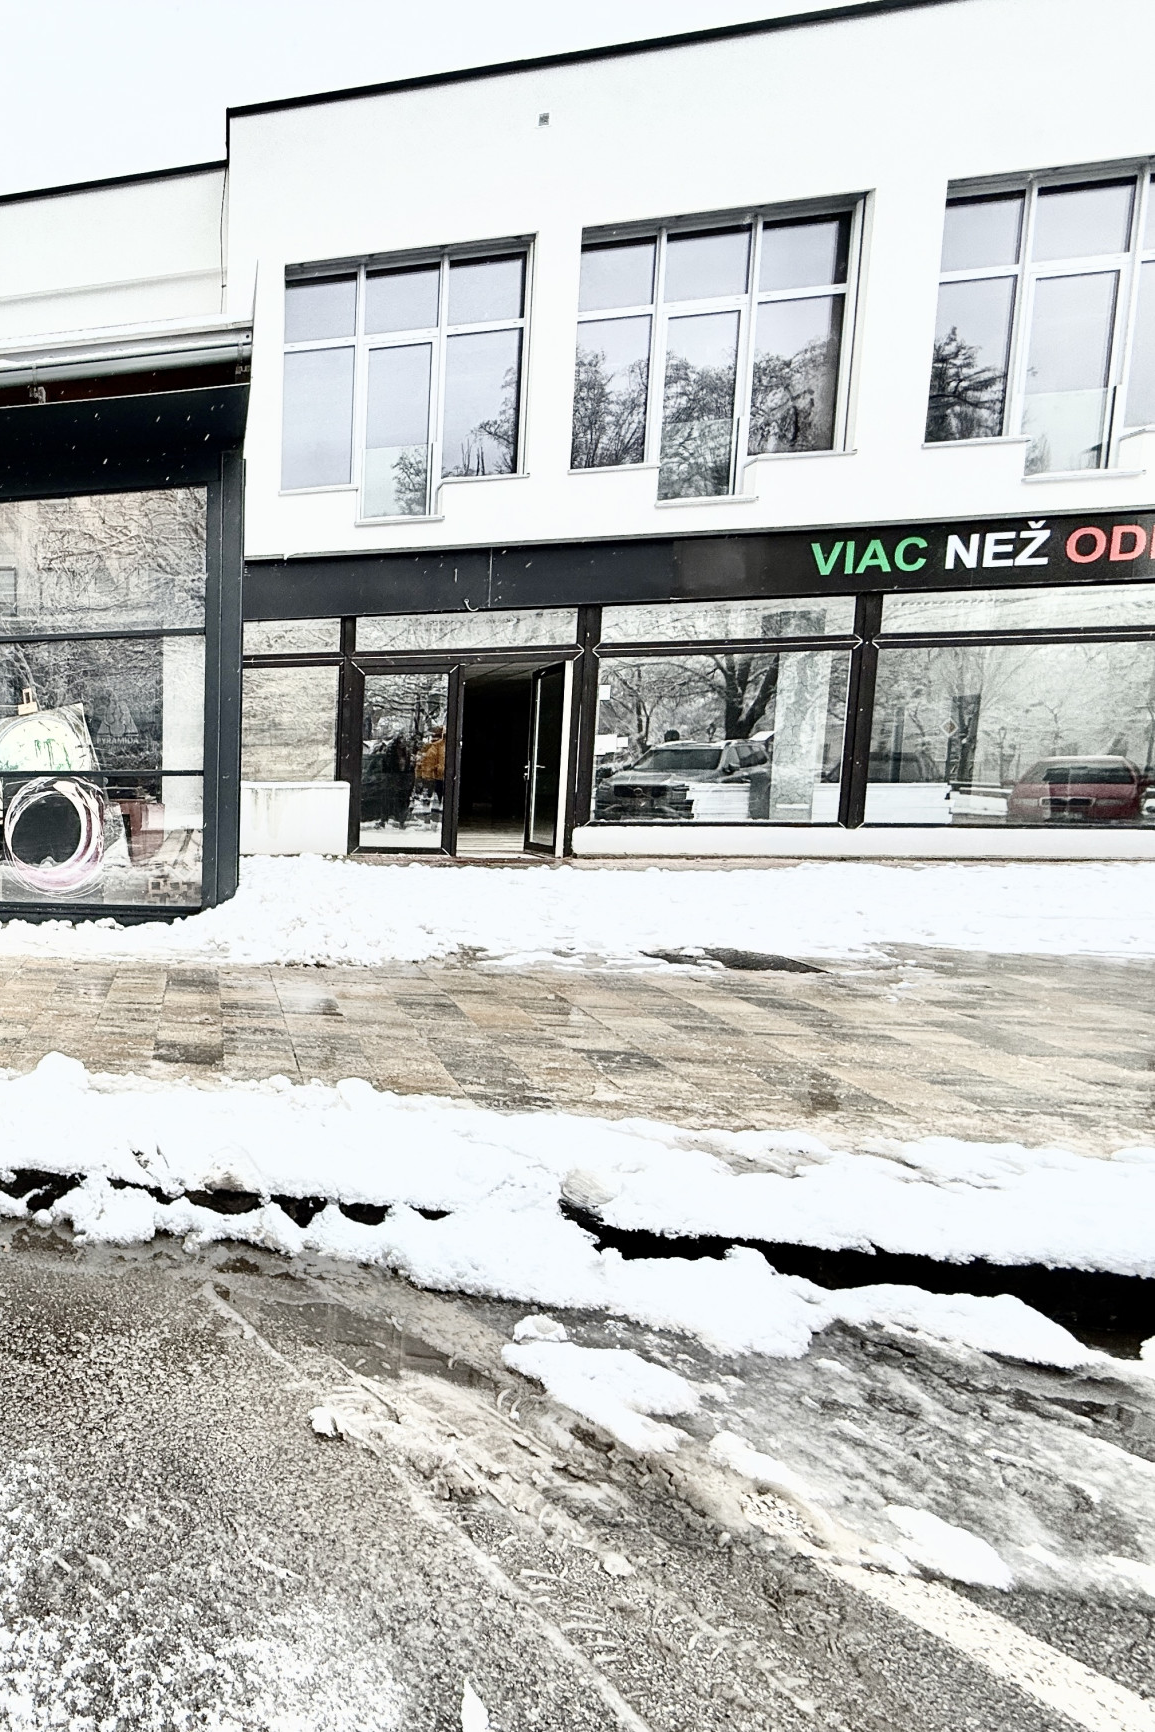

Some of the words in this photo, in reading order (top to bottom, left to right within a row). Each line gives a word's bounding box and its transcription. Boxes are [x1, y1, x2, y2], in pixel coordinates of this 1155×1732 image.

[811, 536, 928, 576] VIAC
[944, 520, 1051, 570] NEŽ
[1065, 523, 1155, 564] OD
